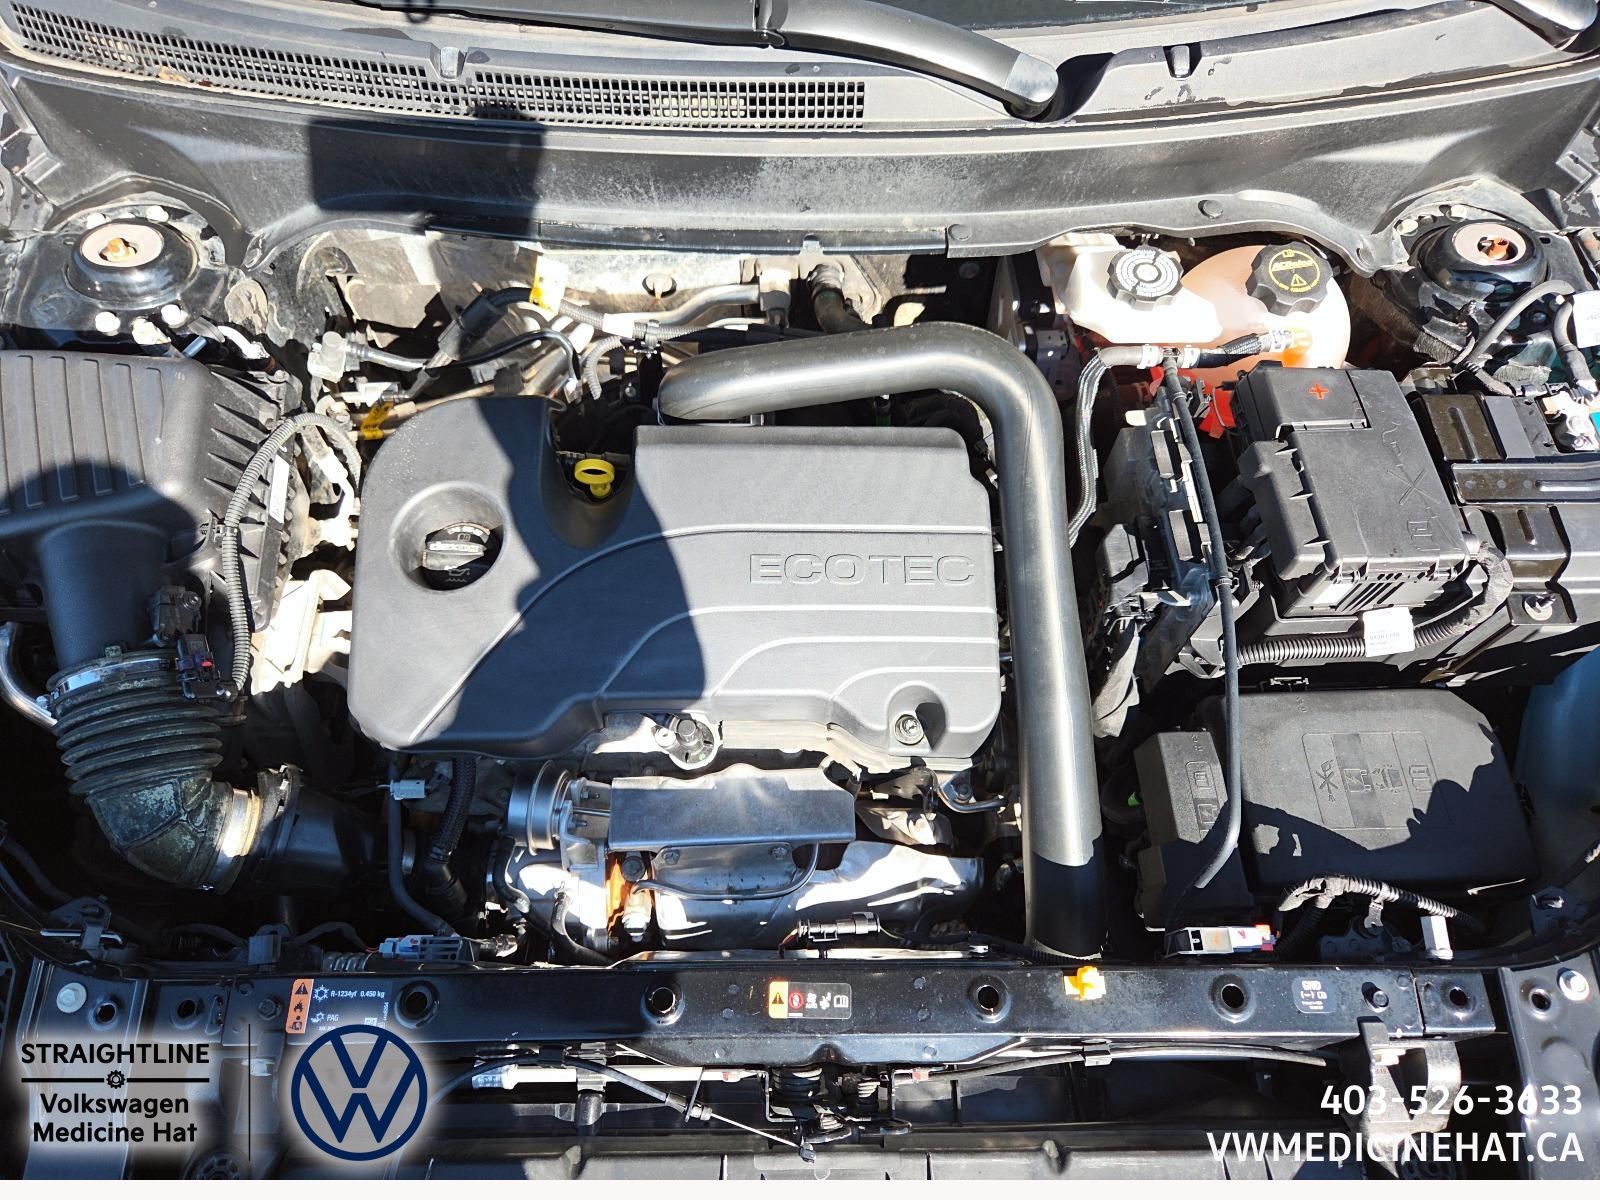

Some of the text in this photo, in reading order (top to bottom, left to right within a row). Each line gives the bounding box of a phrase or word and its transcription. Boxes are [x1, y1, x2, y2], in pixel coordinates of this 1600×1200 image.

[749, 553, 975, 586] ECOTEC
[331, 990, 357, 998] R-1234yf
[377, 990, 385, 998] kg
